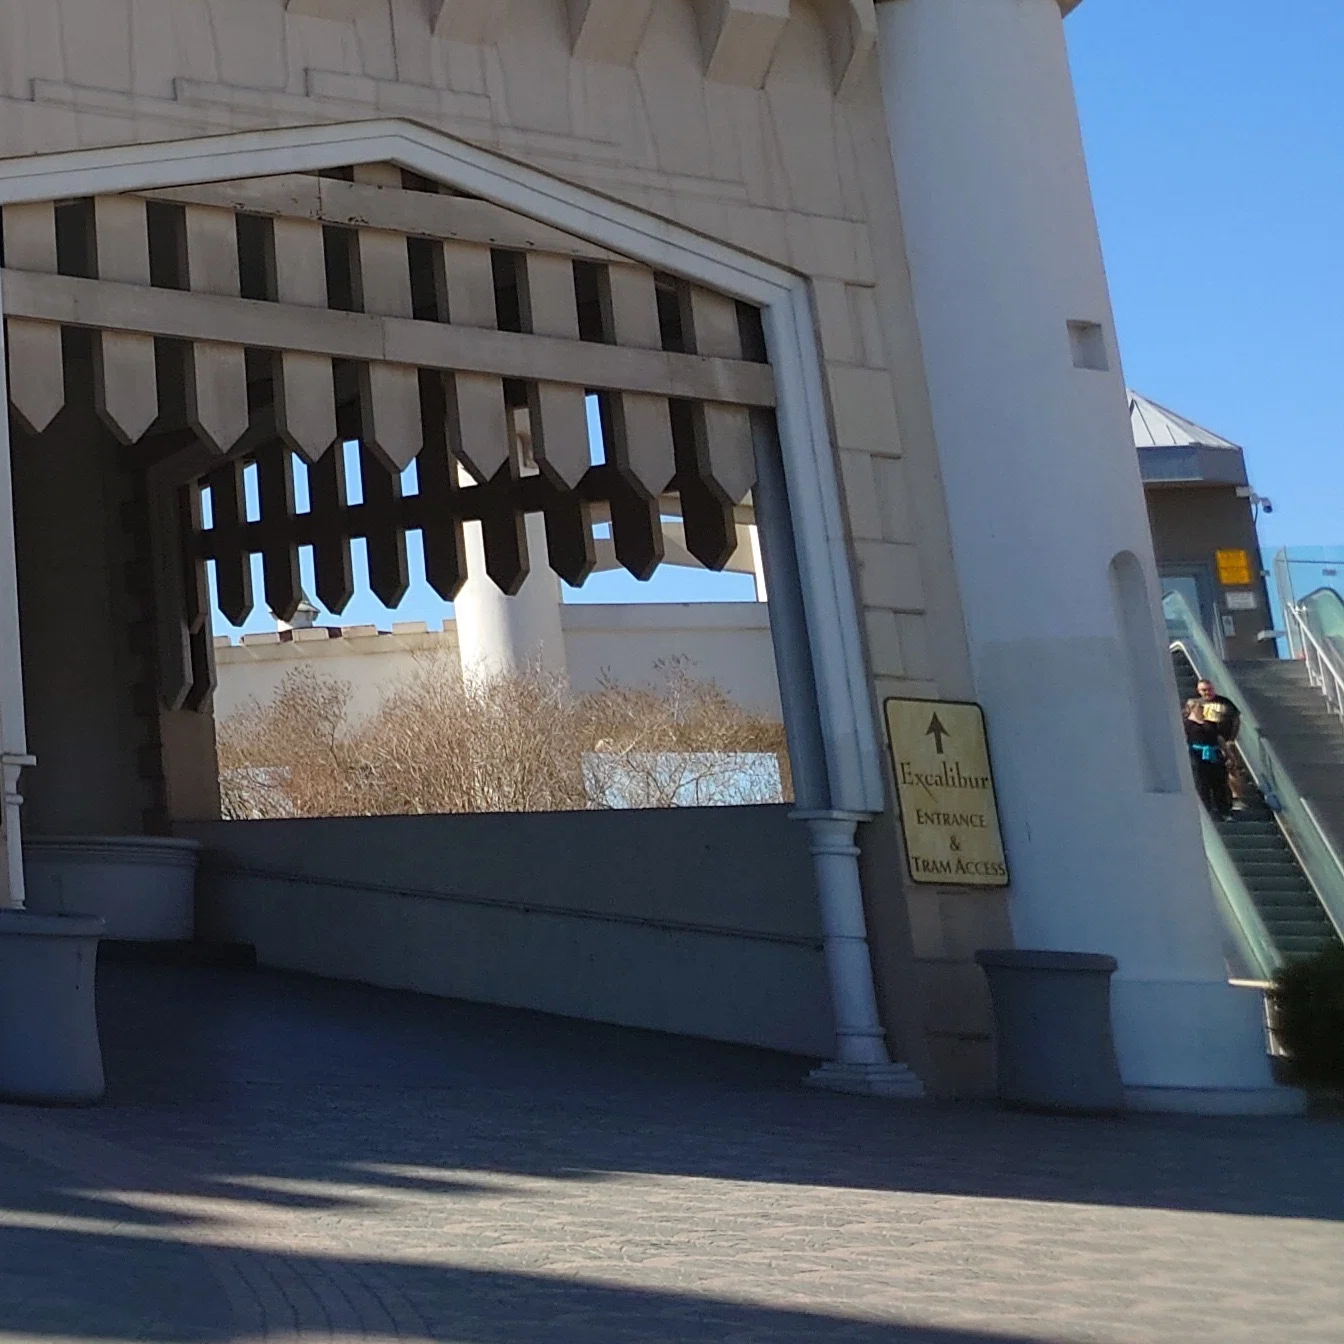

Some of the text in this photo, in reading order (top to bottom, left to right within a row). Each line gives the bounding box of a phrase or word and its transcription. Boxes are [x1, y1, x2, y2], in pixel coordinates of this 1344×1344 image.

[900, 761, 989, 803] Excalibur
[915, 808, 987, 828] ENTRANCE
[949, 835, 961, 851] &
[912, 857, 1006, 876] TRAM ACCESS
